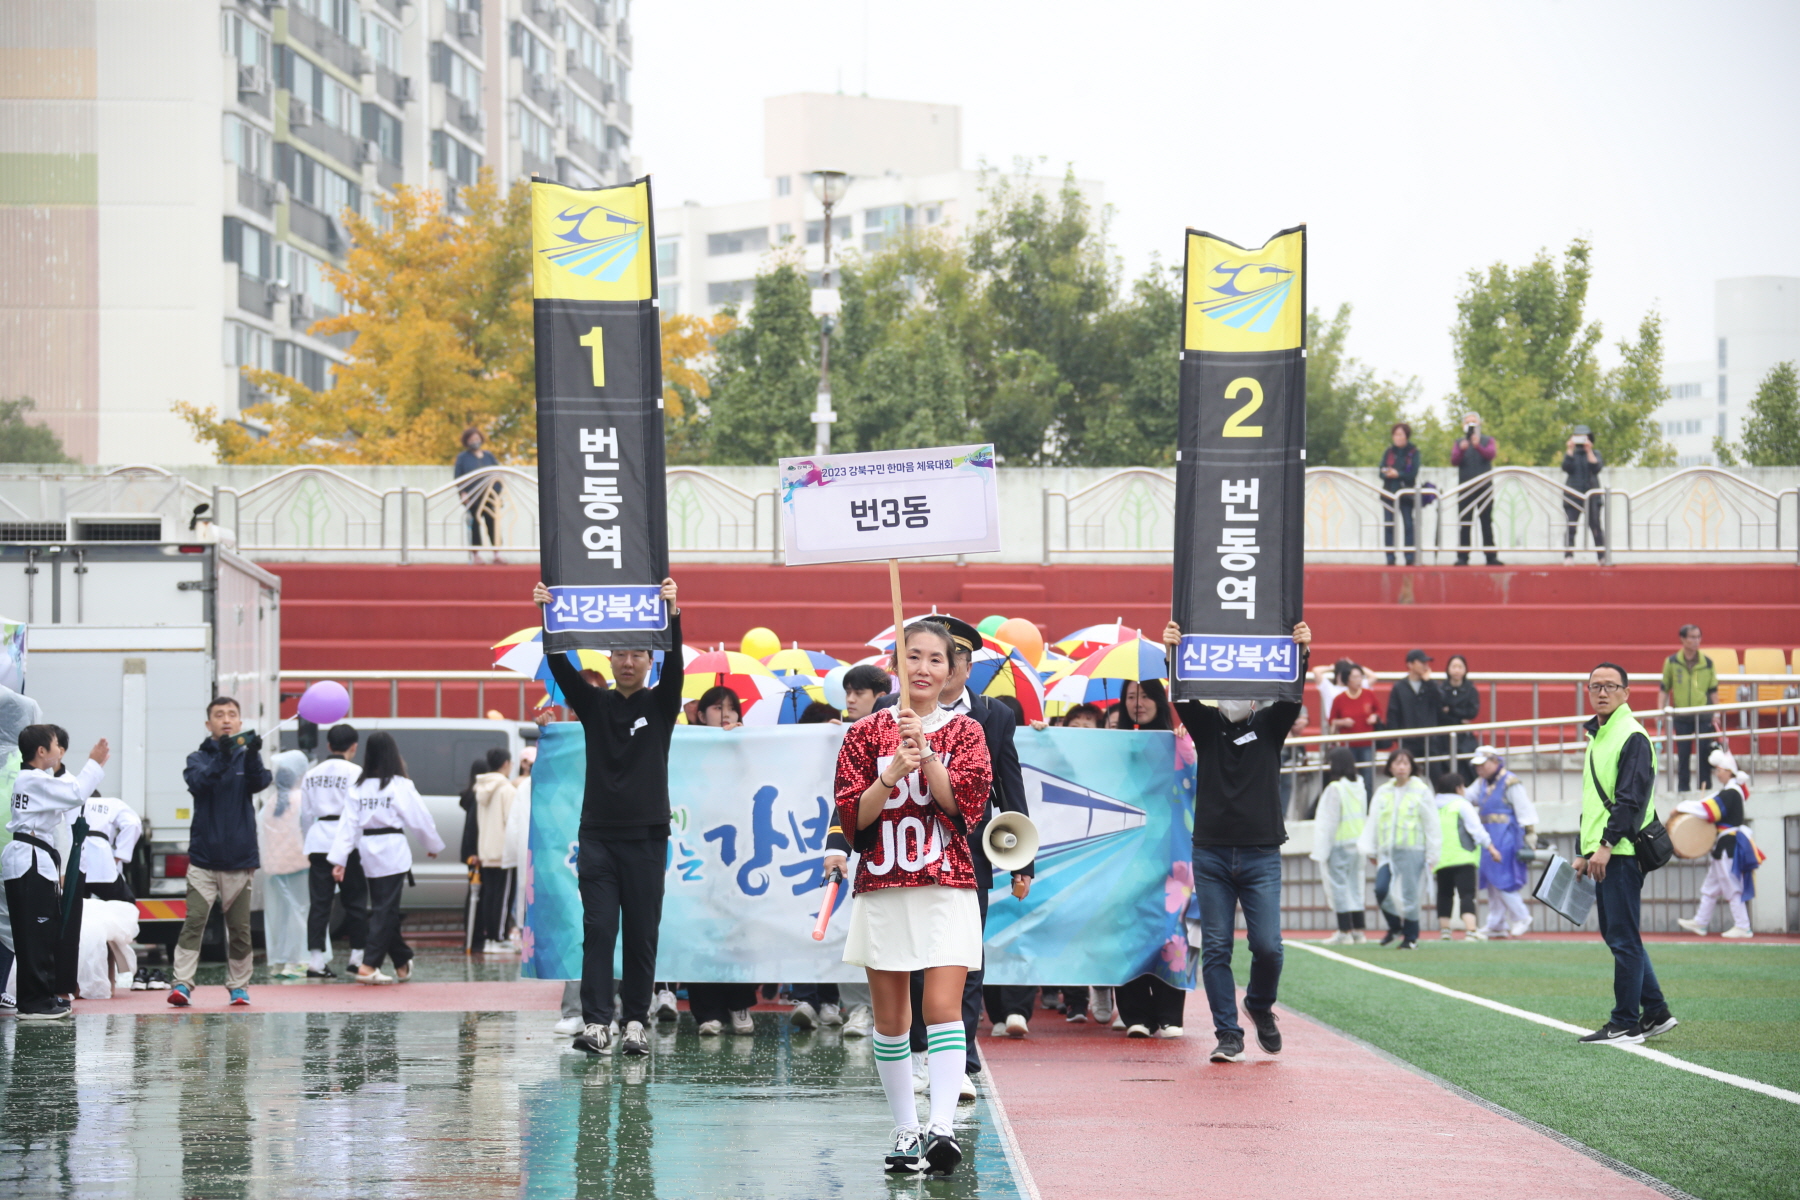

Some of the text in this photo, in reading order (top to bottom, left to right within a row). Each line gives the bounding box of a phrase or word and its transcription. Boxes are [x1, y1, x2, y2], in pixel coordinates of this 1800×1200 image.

[579, 326, 606, 387] 1
[1222, 377, 1264, 438] 2
[821, 459, 953, 478] 2023 강북구민 한마음 체육대회
[578, 426, 624, 570] 번동역
[850, 495, 931, 532] 번3동
[1216, 477, 1261, 620] 번동역
[551, 593, 661, 623] 신강북선
[1183, 643, 1291, 673] 신강북선
